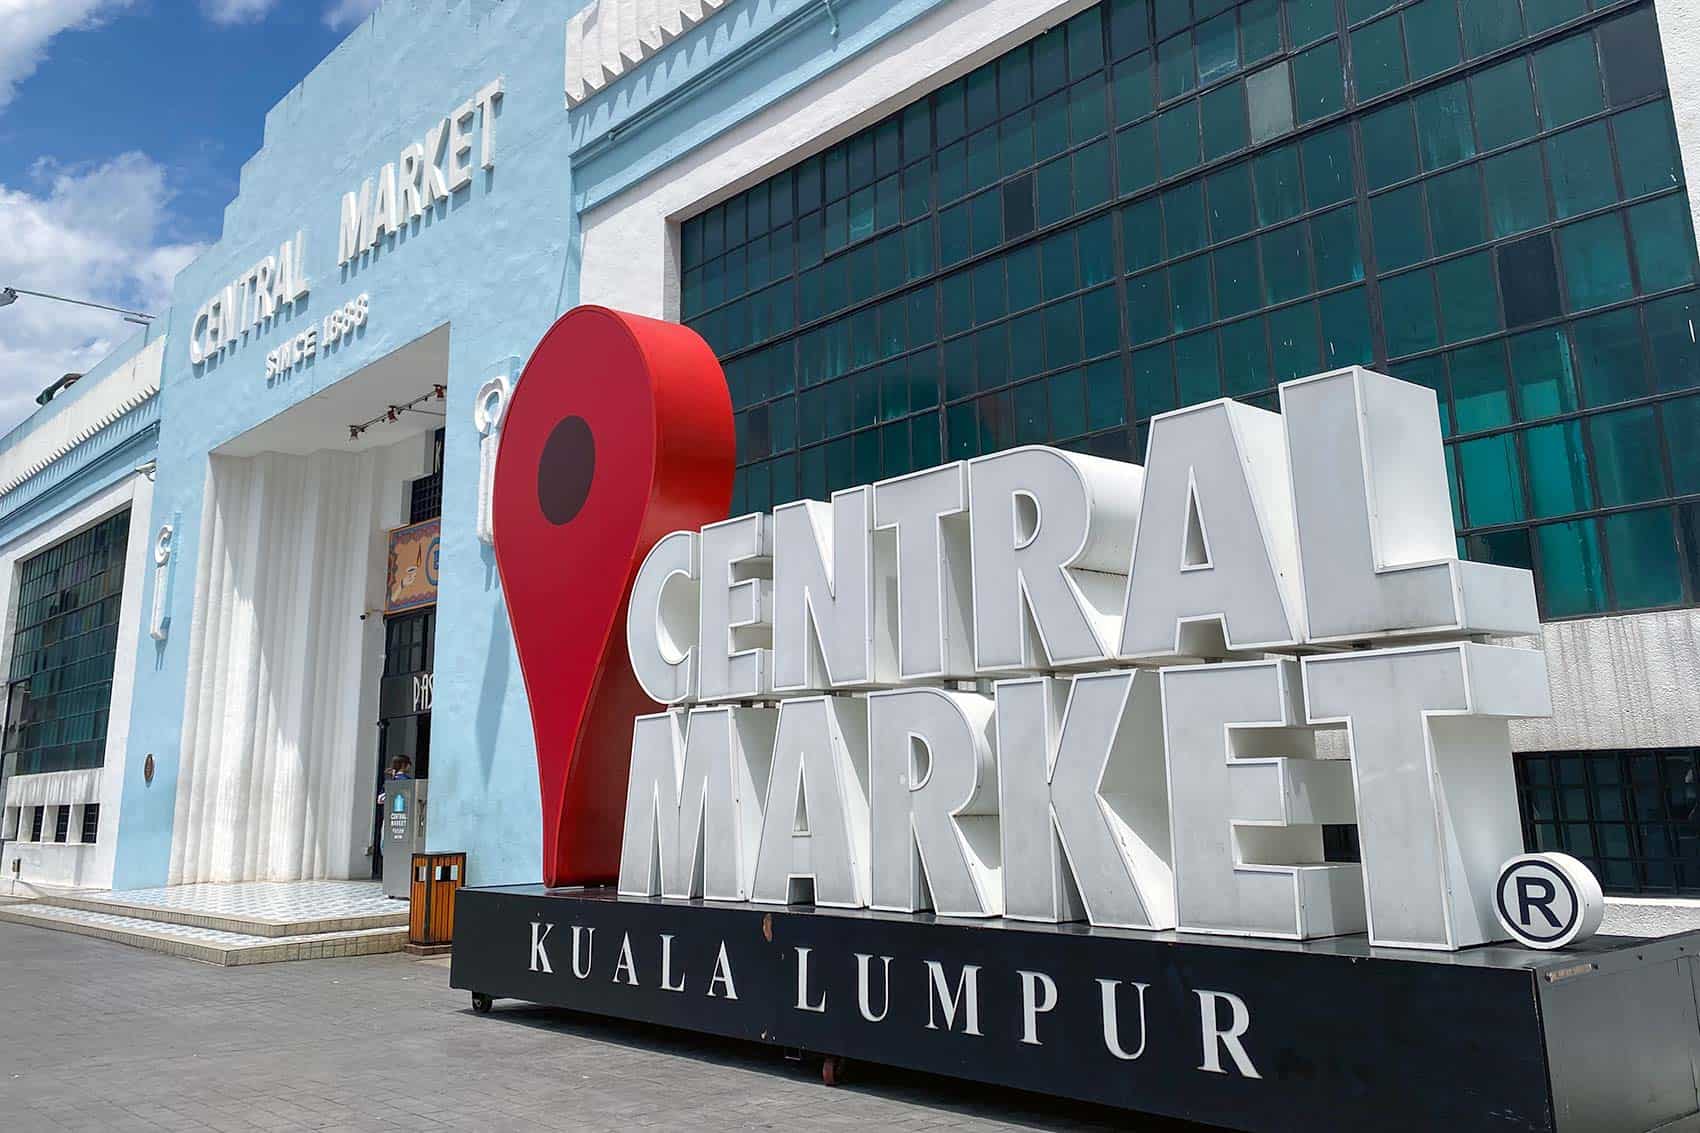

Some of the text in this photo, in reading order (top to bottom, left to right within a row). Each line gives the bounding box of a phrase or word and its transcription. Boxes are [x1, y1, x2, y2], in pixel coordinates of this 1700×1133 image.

[189, 73, 505, 365] CENTRAL MARKET
[265, 293, 369, 380] SINCE 1888
[626, 365, 1464, 706] CENTRAL
[617, 641, 1474, 954] MARKET
[528, 920, 1264, 1080] KUALA LUMPUR
